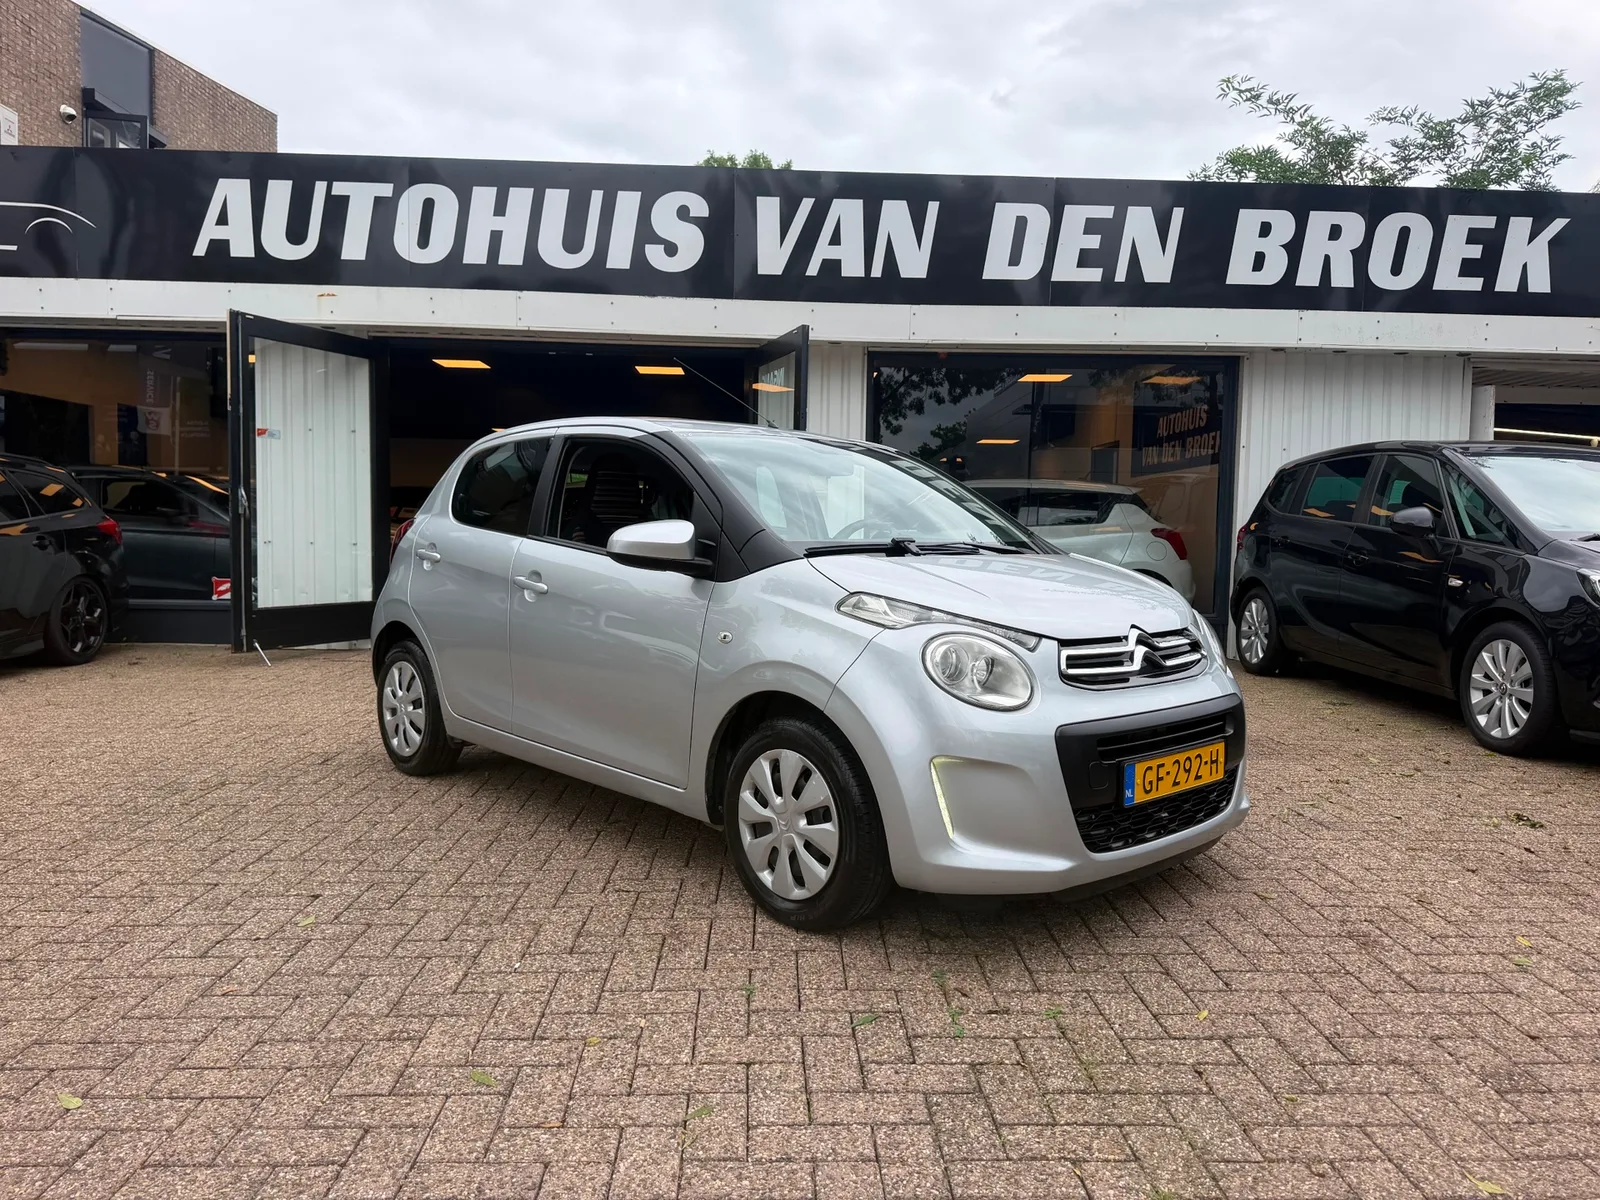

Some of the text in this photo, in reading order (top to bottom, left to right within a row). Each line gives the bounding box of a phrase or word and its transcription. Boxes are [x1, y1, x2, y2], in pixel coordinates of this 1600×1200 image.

[193, 178, 1570, 293] AUTOHUIS VAN DEN BROEK
[1157, 404, 1208, 438] AUTOHUIS
[1143, 445, 1160, 467] VAN
[1162, 441, 1181, 463] DEN
[1142, 748, 1219, 795] GF-292-H
[1125, 788, 1134, 799] NL
